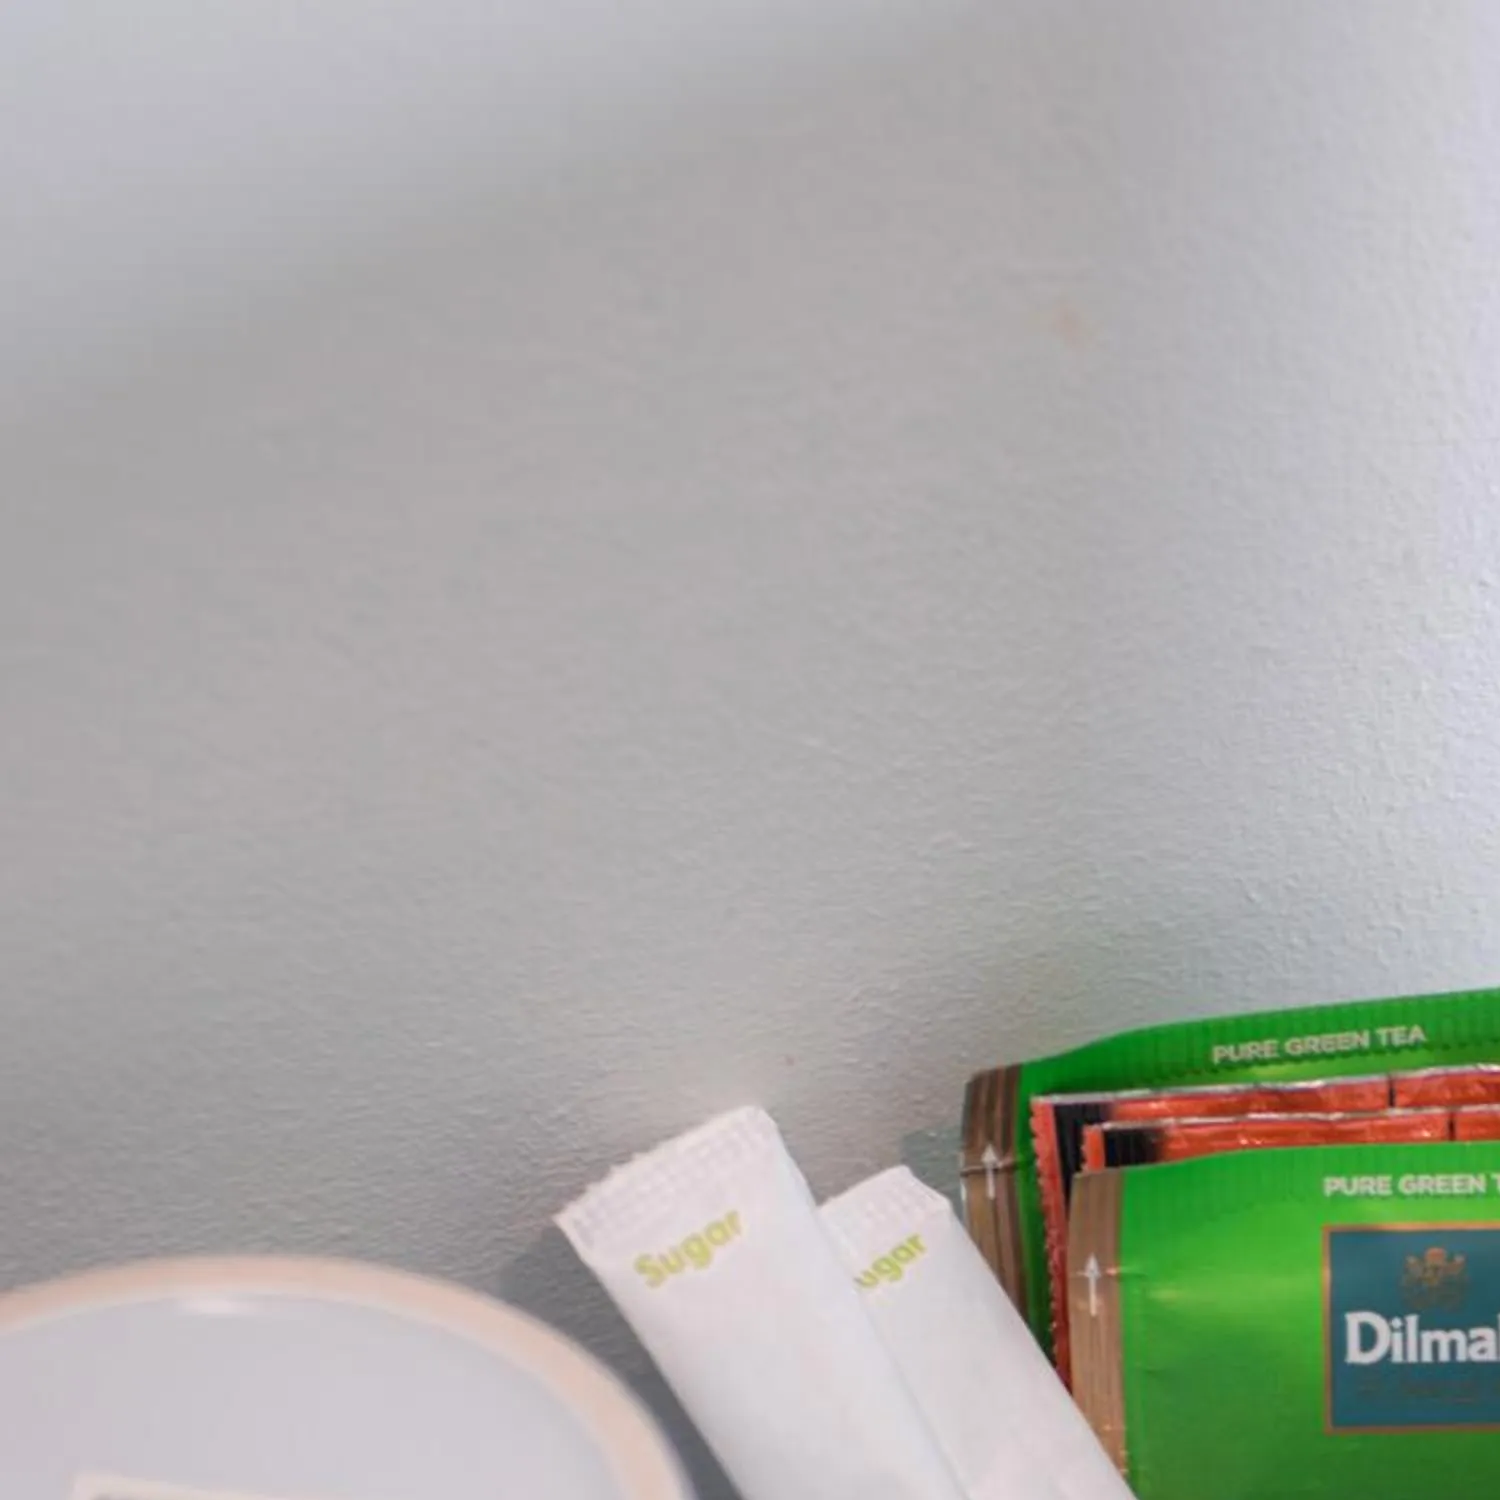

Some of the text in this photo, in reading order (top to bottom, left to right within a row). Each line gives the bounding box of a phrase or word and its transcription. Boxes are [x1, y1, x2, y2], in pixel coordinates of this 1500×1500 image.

[1212, 1025, 1427, 1064] PURE GREEN TEA
[1324, 1175, 1392, 1196] PURE
[1398, 1173, 1486, 1195] GREEN
[634, 1210, 743, 1288] Sugar
[853, 1233, 927, 1289] ugar
